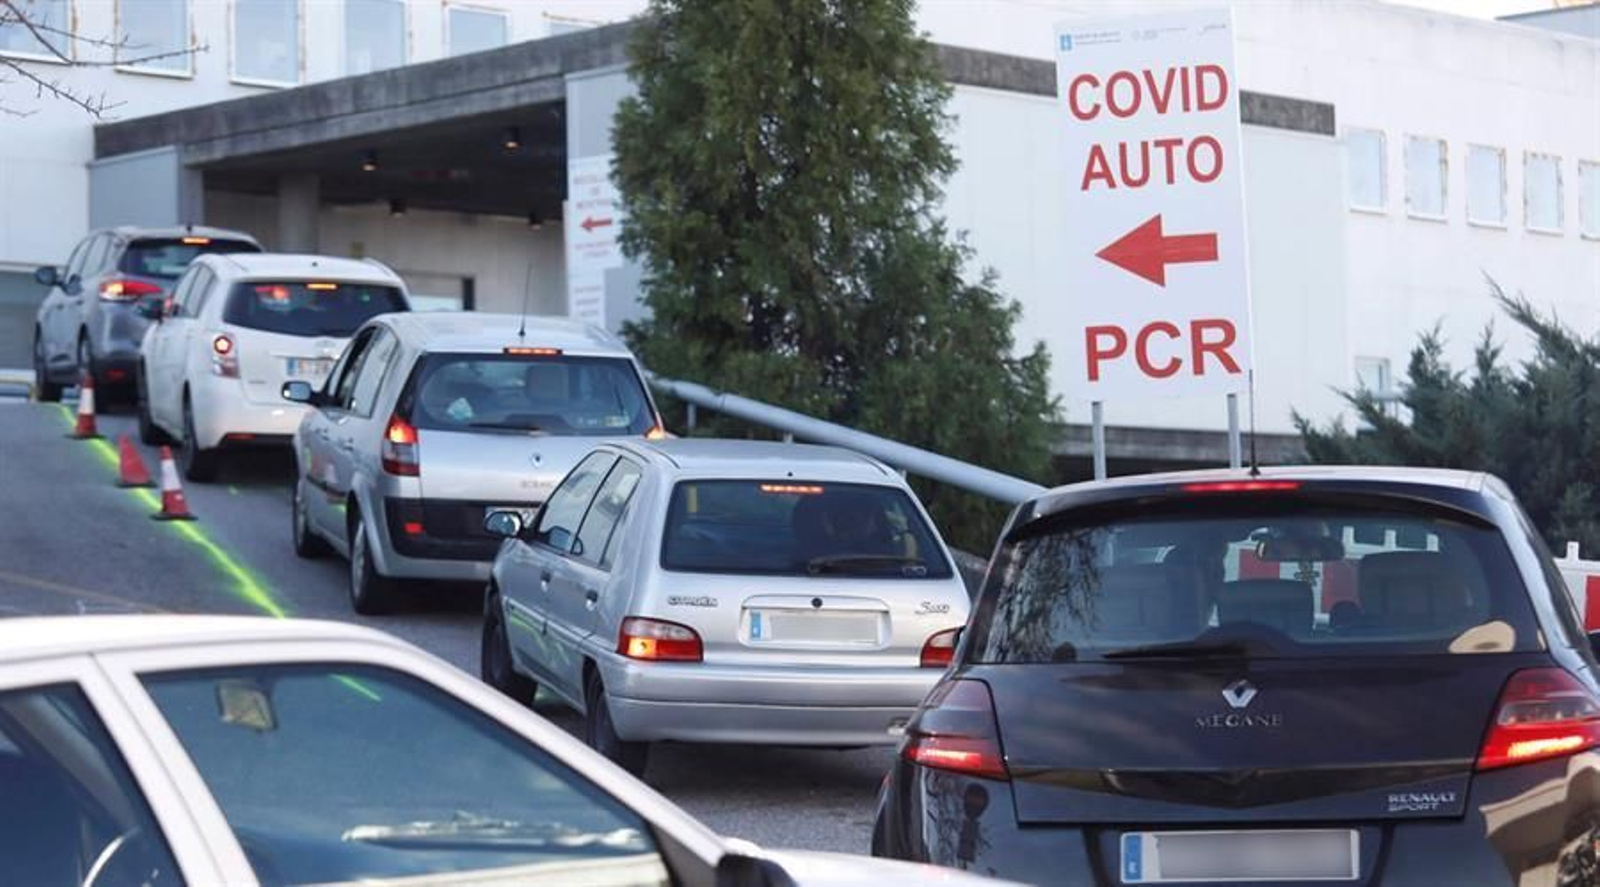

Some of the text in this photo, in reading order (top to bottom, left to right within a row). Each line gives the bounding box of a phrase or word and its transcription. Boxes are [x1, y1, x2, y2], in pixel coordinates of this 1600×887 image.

[1068, 64, 1228, 121] COVID
[1081, 135, 1224, 191] AUTO
[1085, 318, 1242, 382] PCR
[1388, 792, 1456, 803] RENAULT
